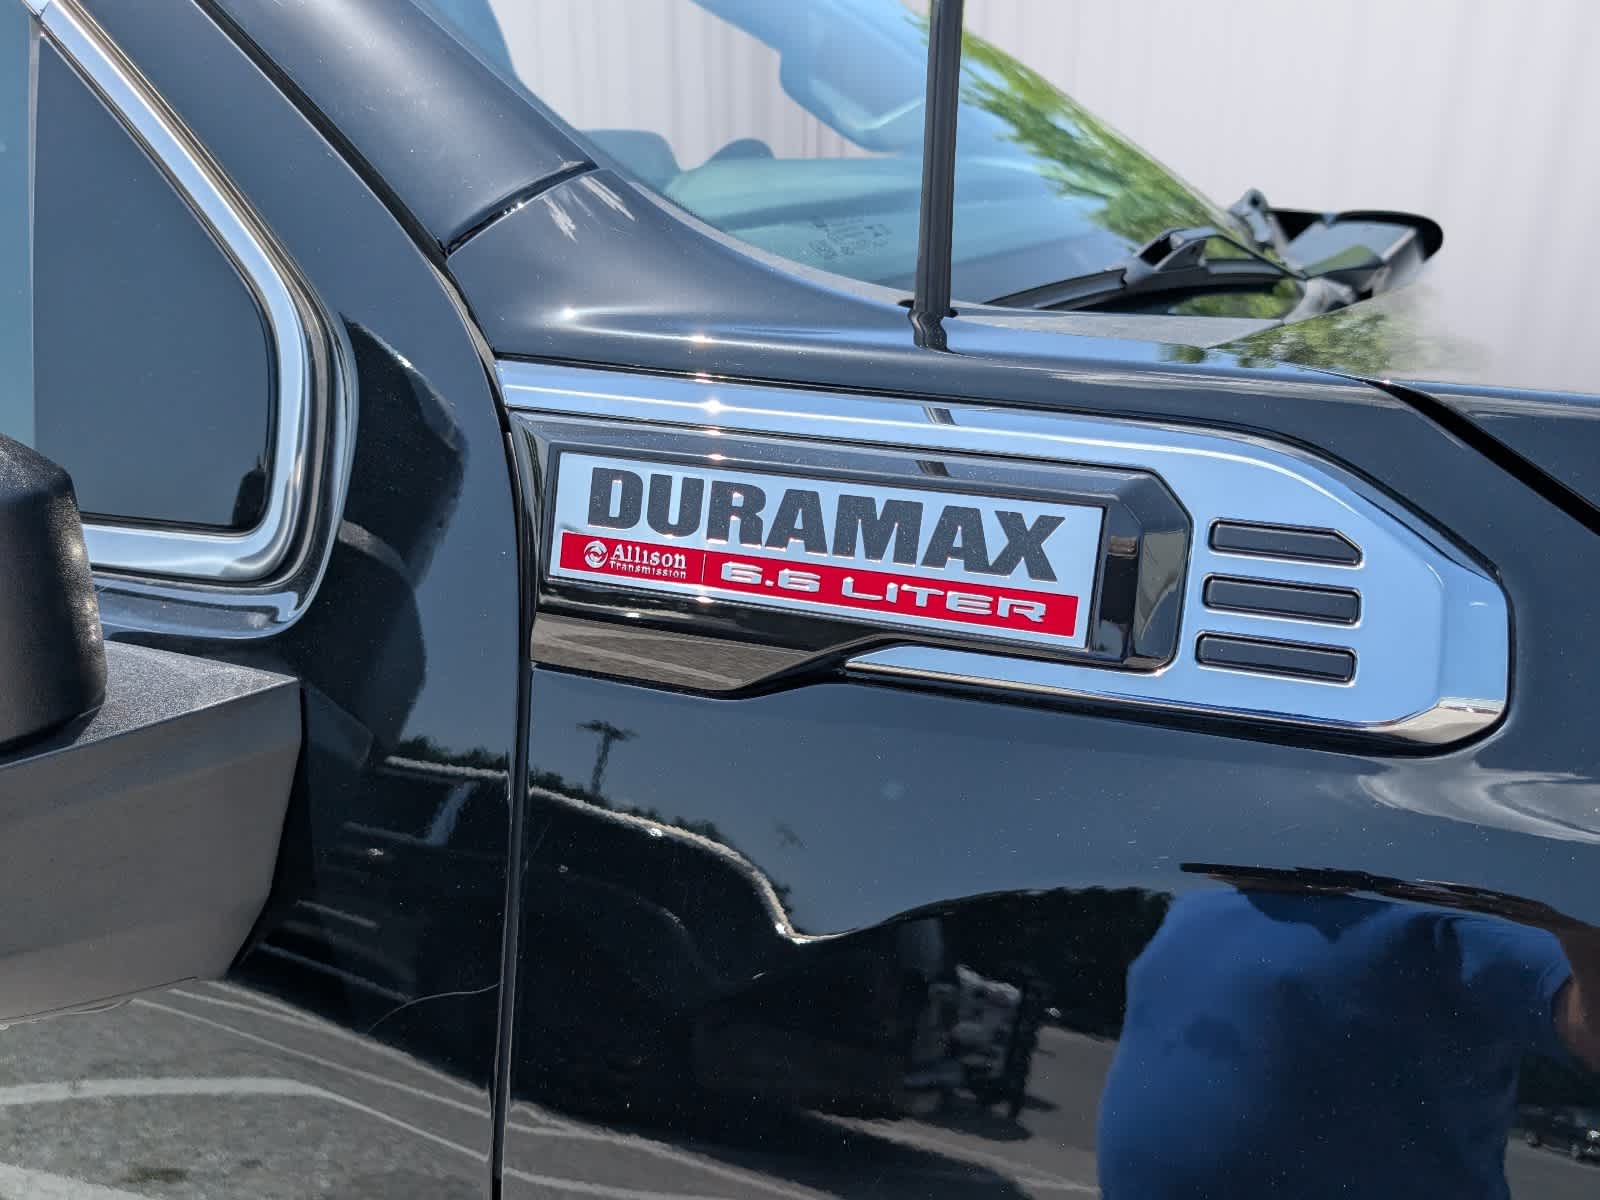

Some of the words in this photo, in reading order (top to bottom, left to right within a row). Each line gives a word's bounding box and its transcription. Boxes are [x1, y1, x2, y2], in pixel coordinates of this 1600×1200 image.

[587, 466, 1065, 582] DURAMAX
[609, 560, 687, 579] Transmission
[610, 543, 687, 569] Allison
[720, 561, 821, 593] 6.6
[841, 577, 1046, 623] LITER
